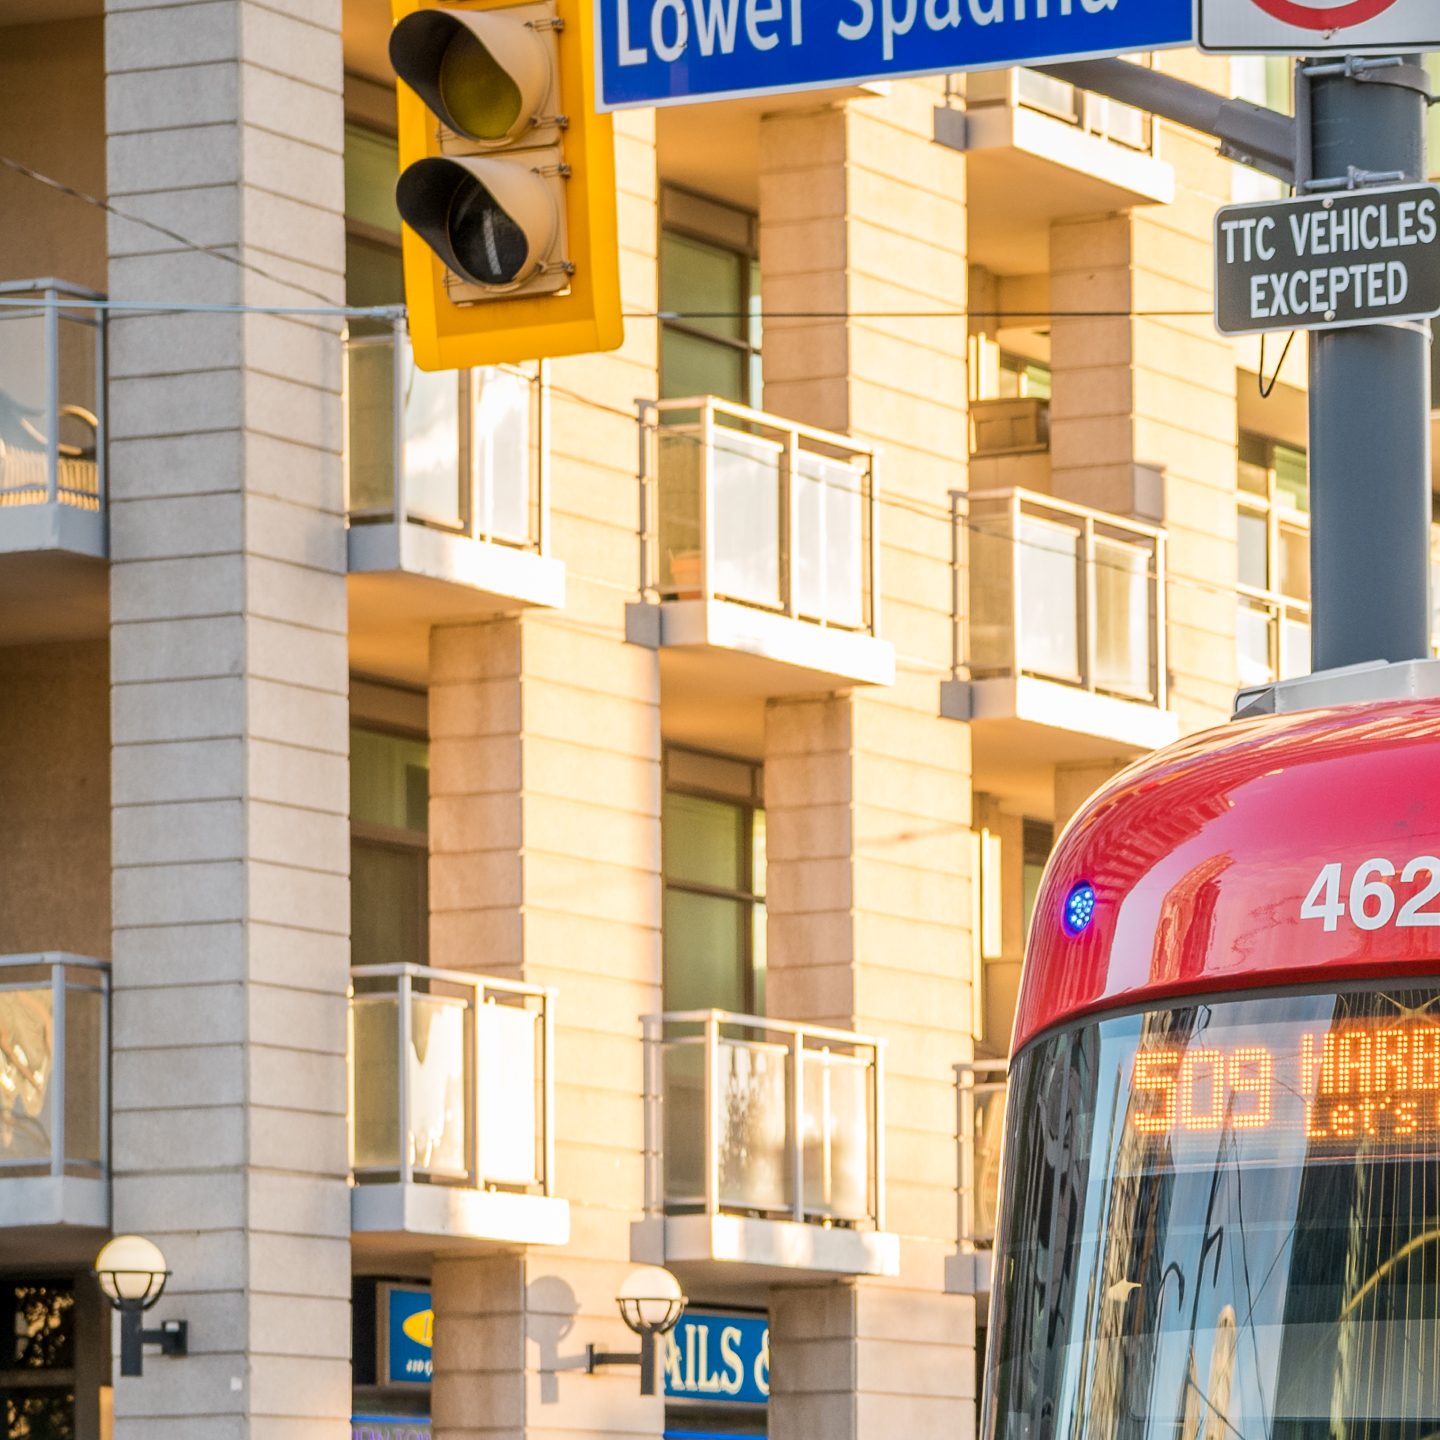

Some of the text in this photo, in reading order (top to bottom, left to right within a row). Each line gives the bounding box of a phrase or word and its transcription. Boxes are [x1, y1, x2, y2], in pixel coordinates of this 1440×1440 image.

[617, 0, 803, 66] Lower
[1221, 199, 1437, 264] TTC VEHICLES
[1250, 261, 1408, 318] EXCEPTED
[1133, 1046, 1272, 1132] 509
[1304, 1097, 1417, 1138] Let's
